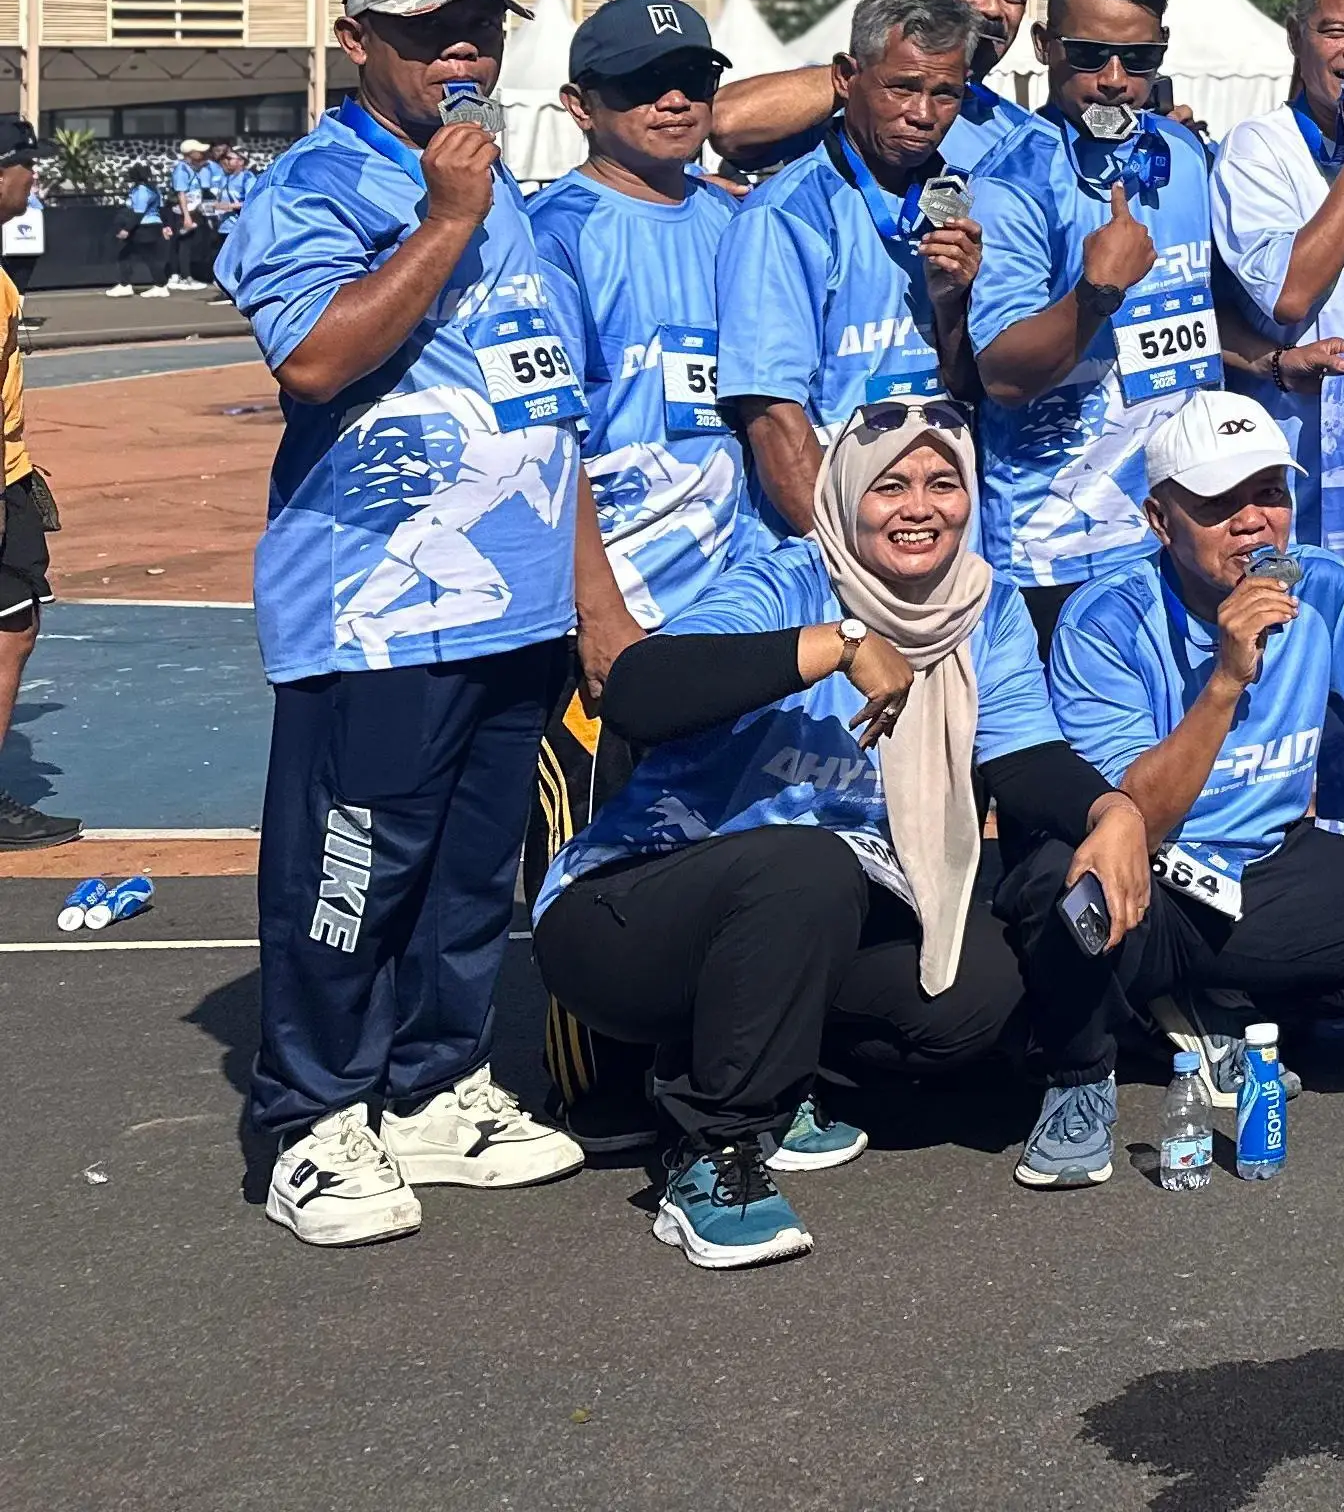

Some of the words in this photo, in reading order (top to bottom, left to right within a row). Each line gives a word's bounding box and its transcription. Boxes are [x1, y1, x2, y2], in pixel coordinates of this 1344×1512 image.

[1139, 320, 1207, 360] 5206
[509, 344, 571, 384] 599
[529, 401, 558, 419] 2025
[696, 415, 721, 426] 2025
[309, 805, 372, 953] NIKE
[1261, 1079, 1282, 1150] ISOPLUS
